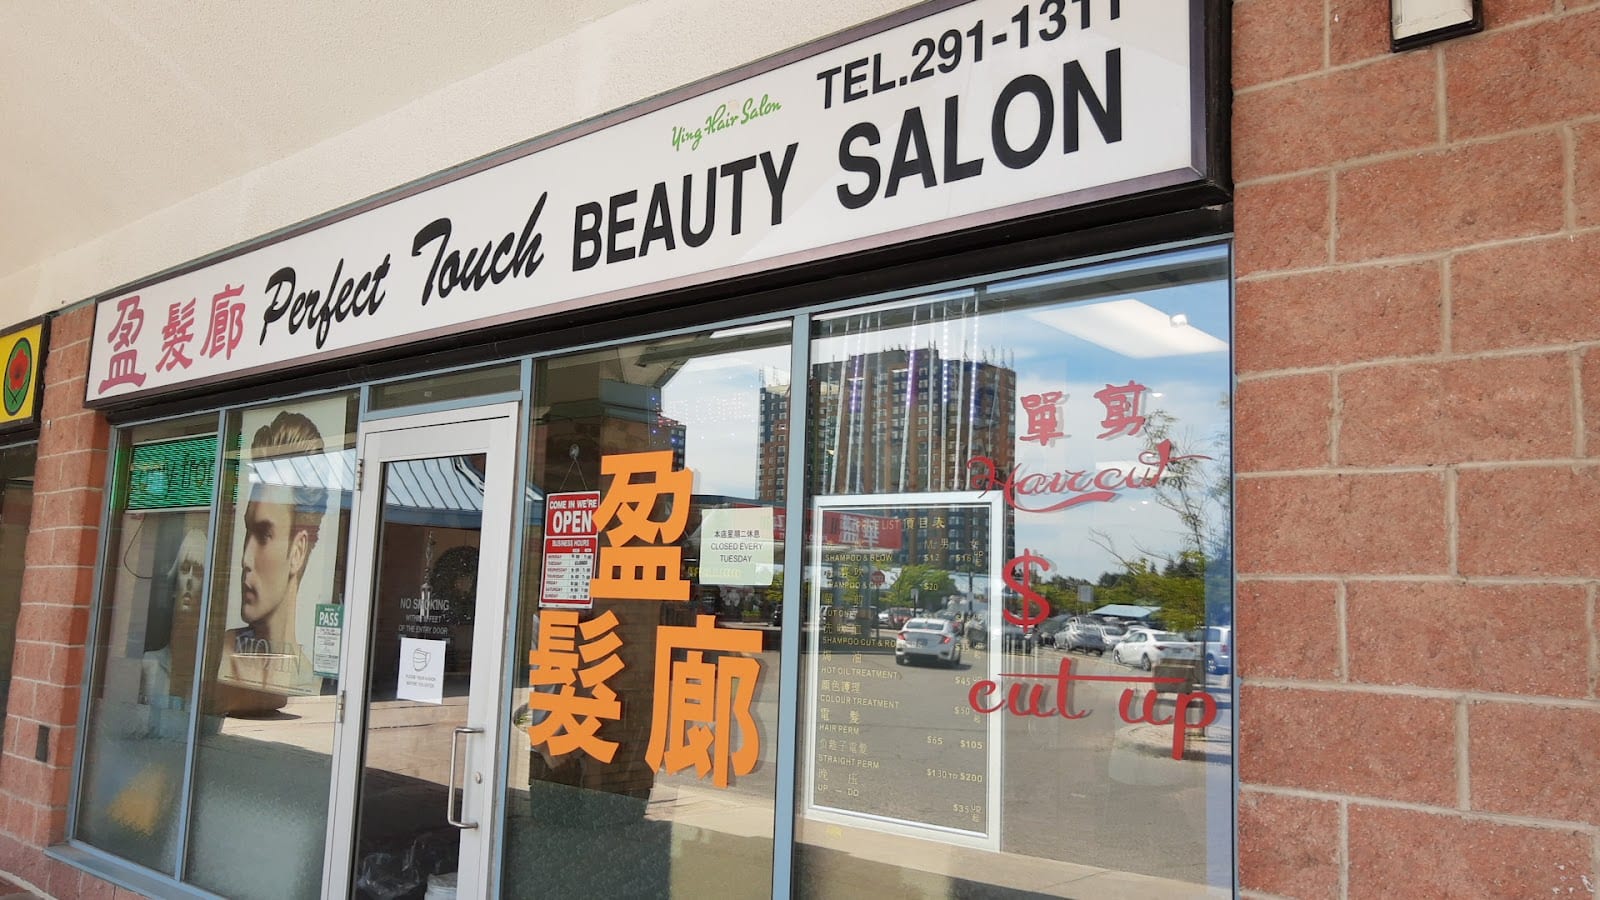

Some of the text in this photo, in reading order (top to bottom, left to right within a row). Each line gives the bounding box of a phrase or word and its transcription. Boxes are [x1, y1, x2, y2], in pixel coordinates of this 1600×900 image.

[672, 94, 781, 151] Ying Hair Salon
[260, 47, 1122, 349] Perfect Touch BEAUTY SALON
[98, 283, 246, 395] 盈髮廊
[967, 439, 1212, 513] Haircut
[549, 499, 597, 509] COME IN WE'RE
[552, 510, 593, 533] OPEN
[589, 450, 694, 601] 盈
[400, 598, 450, 611] NO SMOKING
[319, 611, 339, 626] PASS
[823, 636, 859, 646] SHAMPOO
[860, 638, 876, 646] CUT
[822, 666, 837, 674] HOT
[838, 668, 851, 676] OIL
[852, 668, 898, 679] TREATMENT
[821, 694, 851, 705] COLOUR
[853, 698, 900, 710] TREATMENT
[1119, 689, 1217, 760] up
[819, 724, 837, 733] HAIR
[838, 726, 860, 735] PERM
[960, 740, 984, 750] $105
[818, 754, 856, 767] STRAIGHT
[857, 759, 880, 769] PERM
[927, 768, 947, 779] $130
[960, 772, 983, 783] $200
[817, 783, 829, 792] UP
